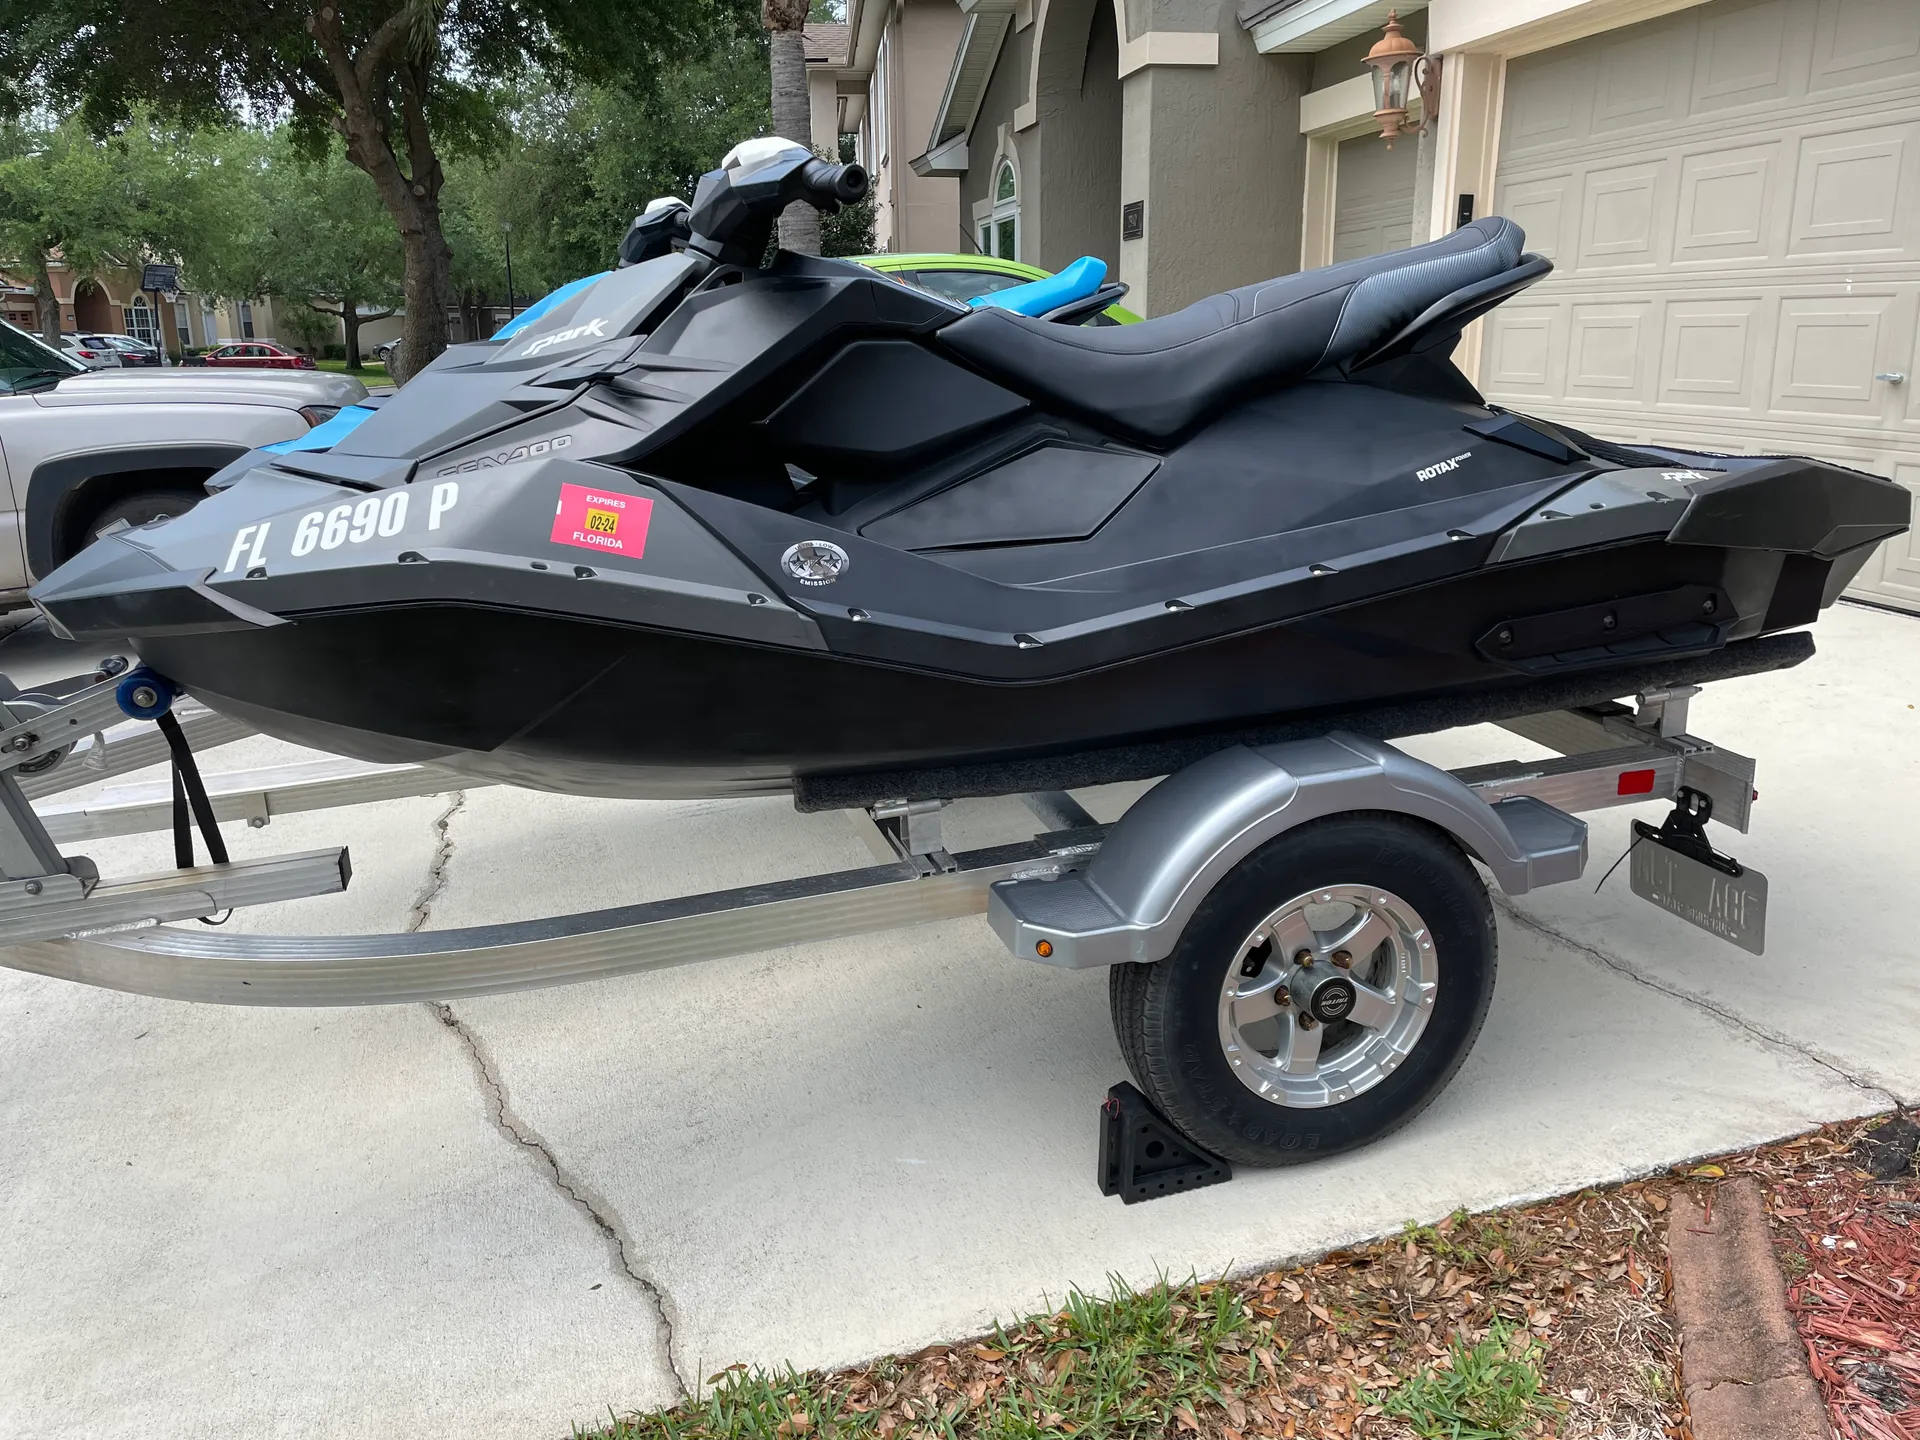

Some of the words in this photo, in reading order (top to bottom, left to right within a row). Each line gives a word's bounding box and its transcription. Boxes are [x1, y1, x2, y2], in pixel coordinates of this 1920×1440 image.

[1416, 457, 1460, 482] ROTAX
[586, 494, 626, 509] EXPIRES
[223, 522, 271, 573] FL
[290, 491, 410, 557] 6690
[428, 481, 459, 531] P
[590, 514, 616, 534] 02-24
[572, 531, 623, 549] FLORIDA
[800, 577, 836, 587] EMISSION
[1242, 1122, 1322, 1150] LOAD
